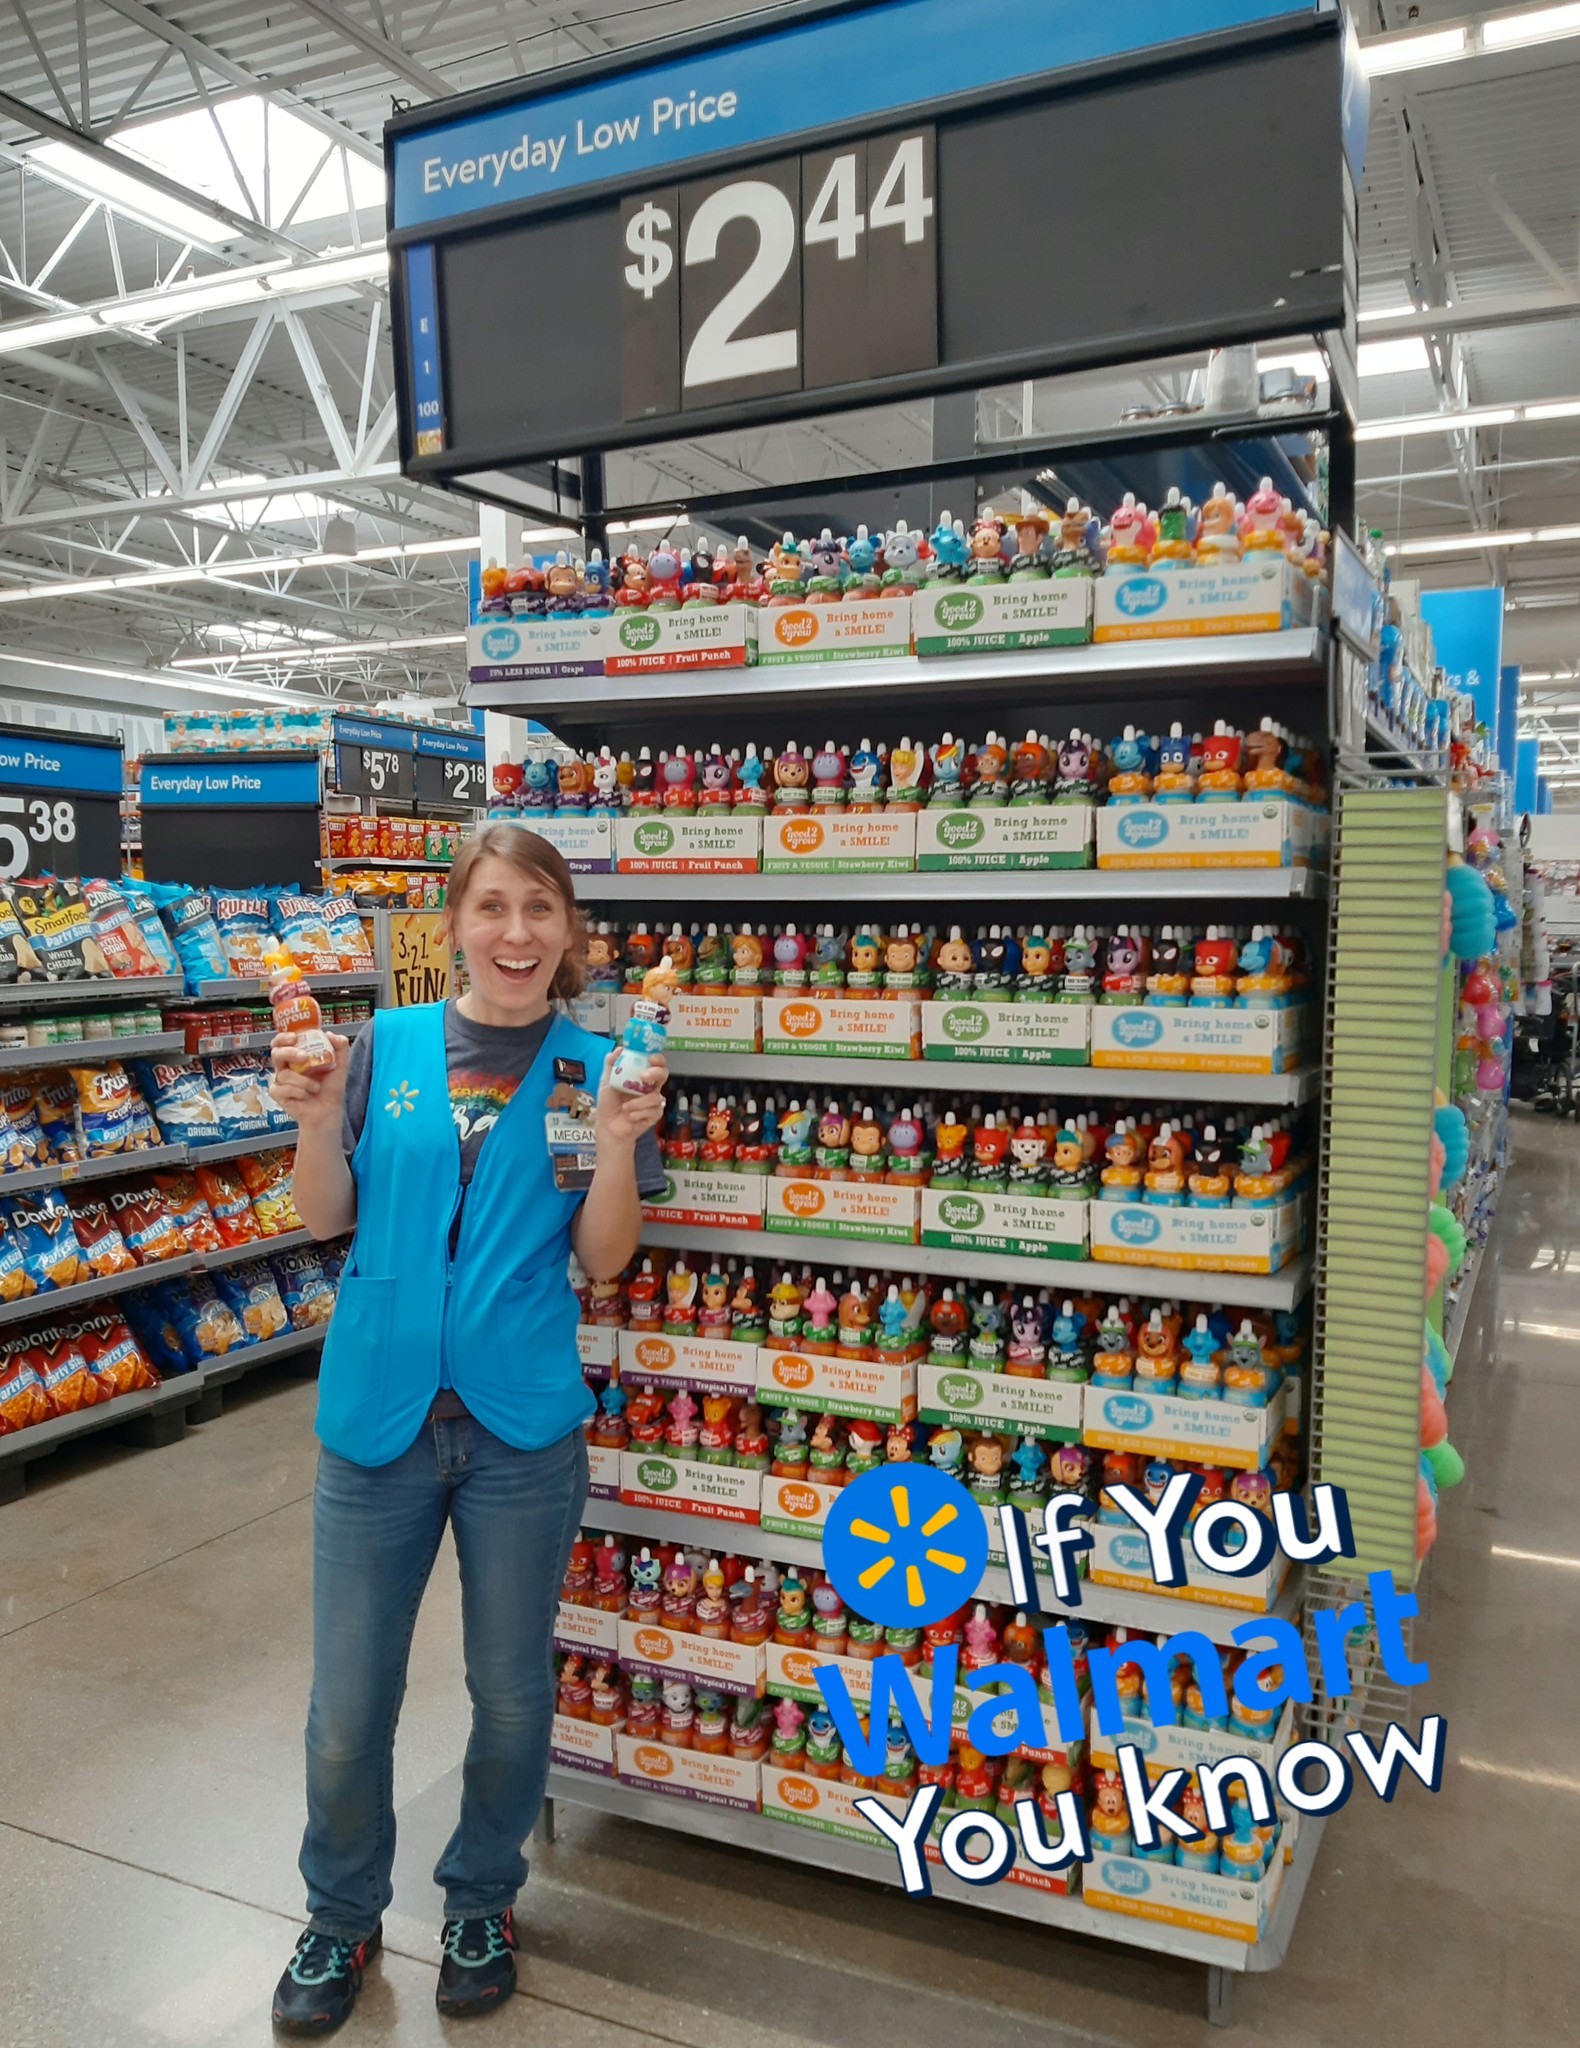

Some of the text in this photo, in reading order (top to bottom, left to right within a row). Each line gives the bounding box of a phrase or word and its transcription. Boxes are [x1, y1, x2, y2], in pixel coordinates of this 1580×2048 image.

[424, 89, 738, 195] Everyday Low Price
[417, 400, 440, 417] 100
[993, 592, 1068, 605] Bring home
[827, 610, 894, 623] Bring home
[940, 600, 977, 620] good2
[1012, 607, 1058, 619] SMILE!
[668, 614, 730, 628] Bring home
[947, 611, 976, 627] grow
[675, 627, 722, 641] a SMILE!
[780, 617, 814, 637] good2
[835, 624, 886, 637] a SMILE!
[787, 628, 812, 643] grow
[946, 632, 1050, 648] 100% JUICE Apple
[882, 647, 905, 656] Kiwi
[617, 650, 731, 668] 100% JUICE Fruit Punch
[561, 665, 584, 674] Grape
[338, 724, 383, 740] Everyday Low Price
[422, 738, 469, 753] Everyday Low Price
[0, 752, 62, 772] ow Price
[151, 775, 262, 794] Everyday Low Price
[832, 823, 899, 834] Bring home
[942, 820, 978, 838] good2
[994, 816, 1068, 828] Bring home
[639, 828, 669, 846] good2
[681, 826, 744, 837] Bring home
[786, 826, 818, 844] good2
[949, 831, 977, 845] grow
[1013, 831, 1058, 841] SMILE!
[645, 839, 668, 851] grow
[698, 840, 736, 849] SMILE!
[791, 836, 817, 849] grow
[850, 836, 891, 847] SMILE!
[630, 860, 744, 870] 100% JUICE Fruit Punch
[838, 860, 885, 870] Strawberry
[887, 859, 910, 868] Kiwi
[948, 854, 1049, 866] 100% JUICE Apple
[46, 930, 73, 947] Party
[48, 949, 75, 960] WHITE
[103, 942, 127, 956] CORN
[46, 957, 83, 971] CHEDDAR
[830, 1009, 896, 1020] Bring home
[998, 1013, 1069, 1025] Bring home
[847, 1023, 887, 1033] SMILE!
[1016, 1028, 1060, 1037] SMILE!
[954, 1047, 1052, 1061] 100% JUICE Apple
[656, 1209, 749, 1225] JUICE Fruit Punch
[141, 1222, 165, 1242] Party
[1018, 1240, 1049, 1253] Apple
[695, 1380, 748, 1394] Tropical Fruit
[691, 1502, 746, 1519] Fruit Punch
[590, 1646, 610, 1659] Fruit
[694, 1675, 748, 1693] Tropical Fruit
[1018, 1872, 1051, 1888] Punch
